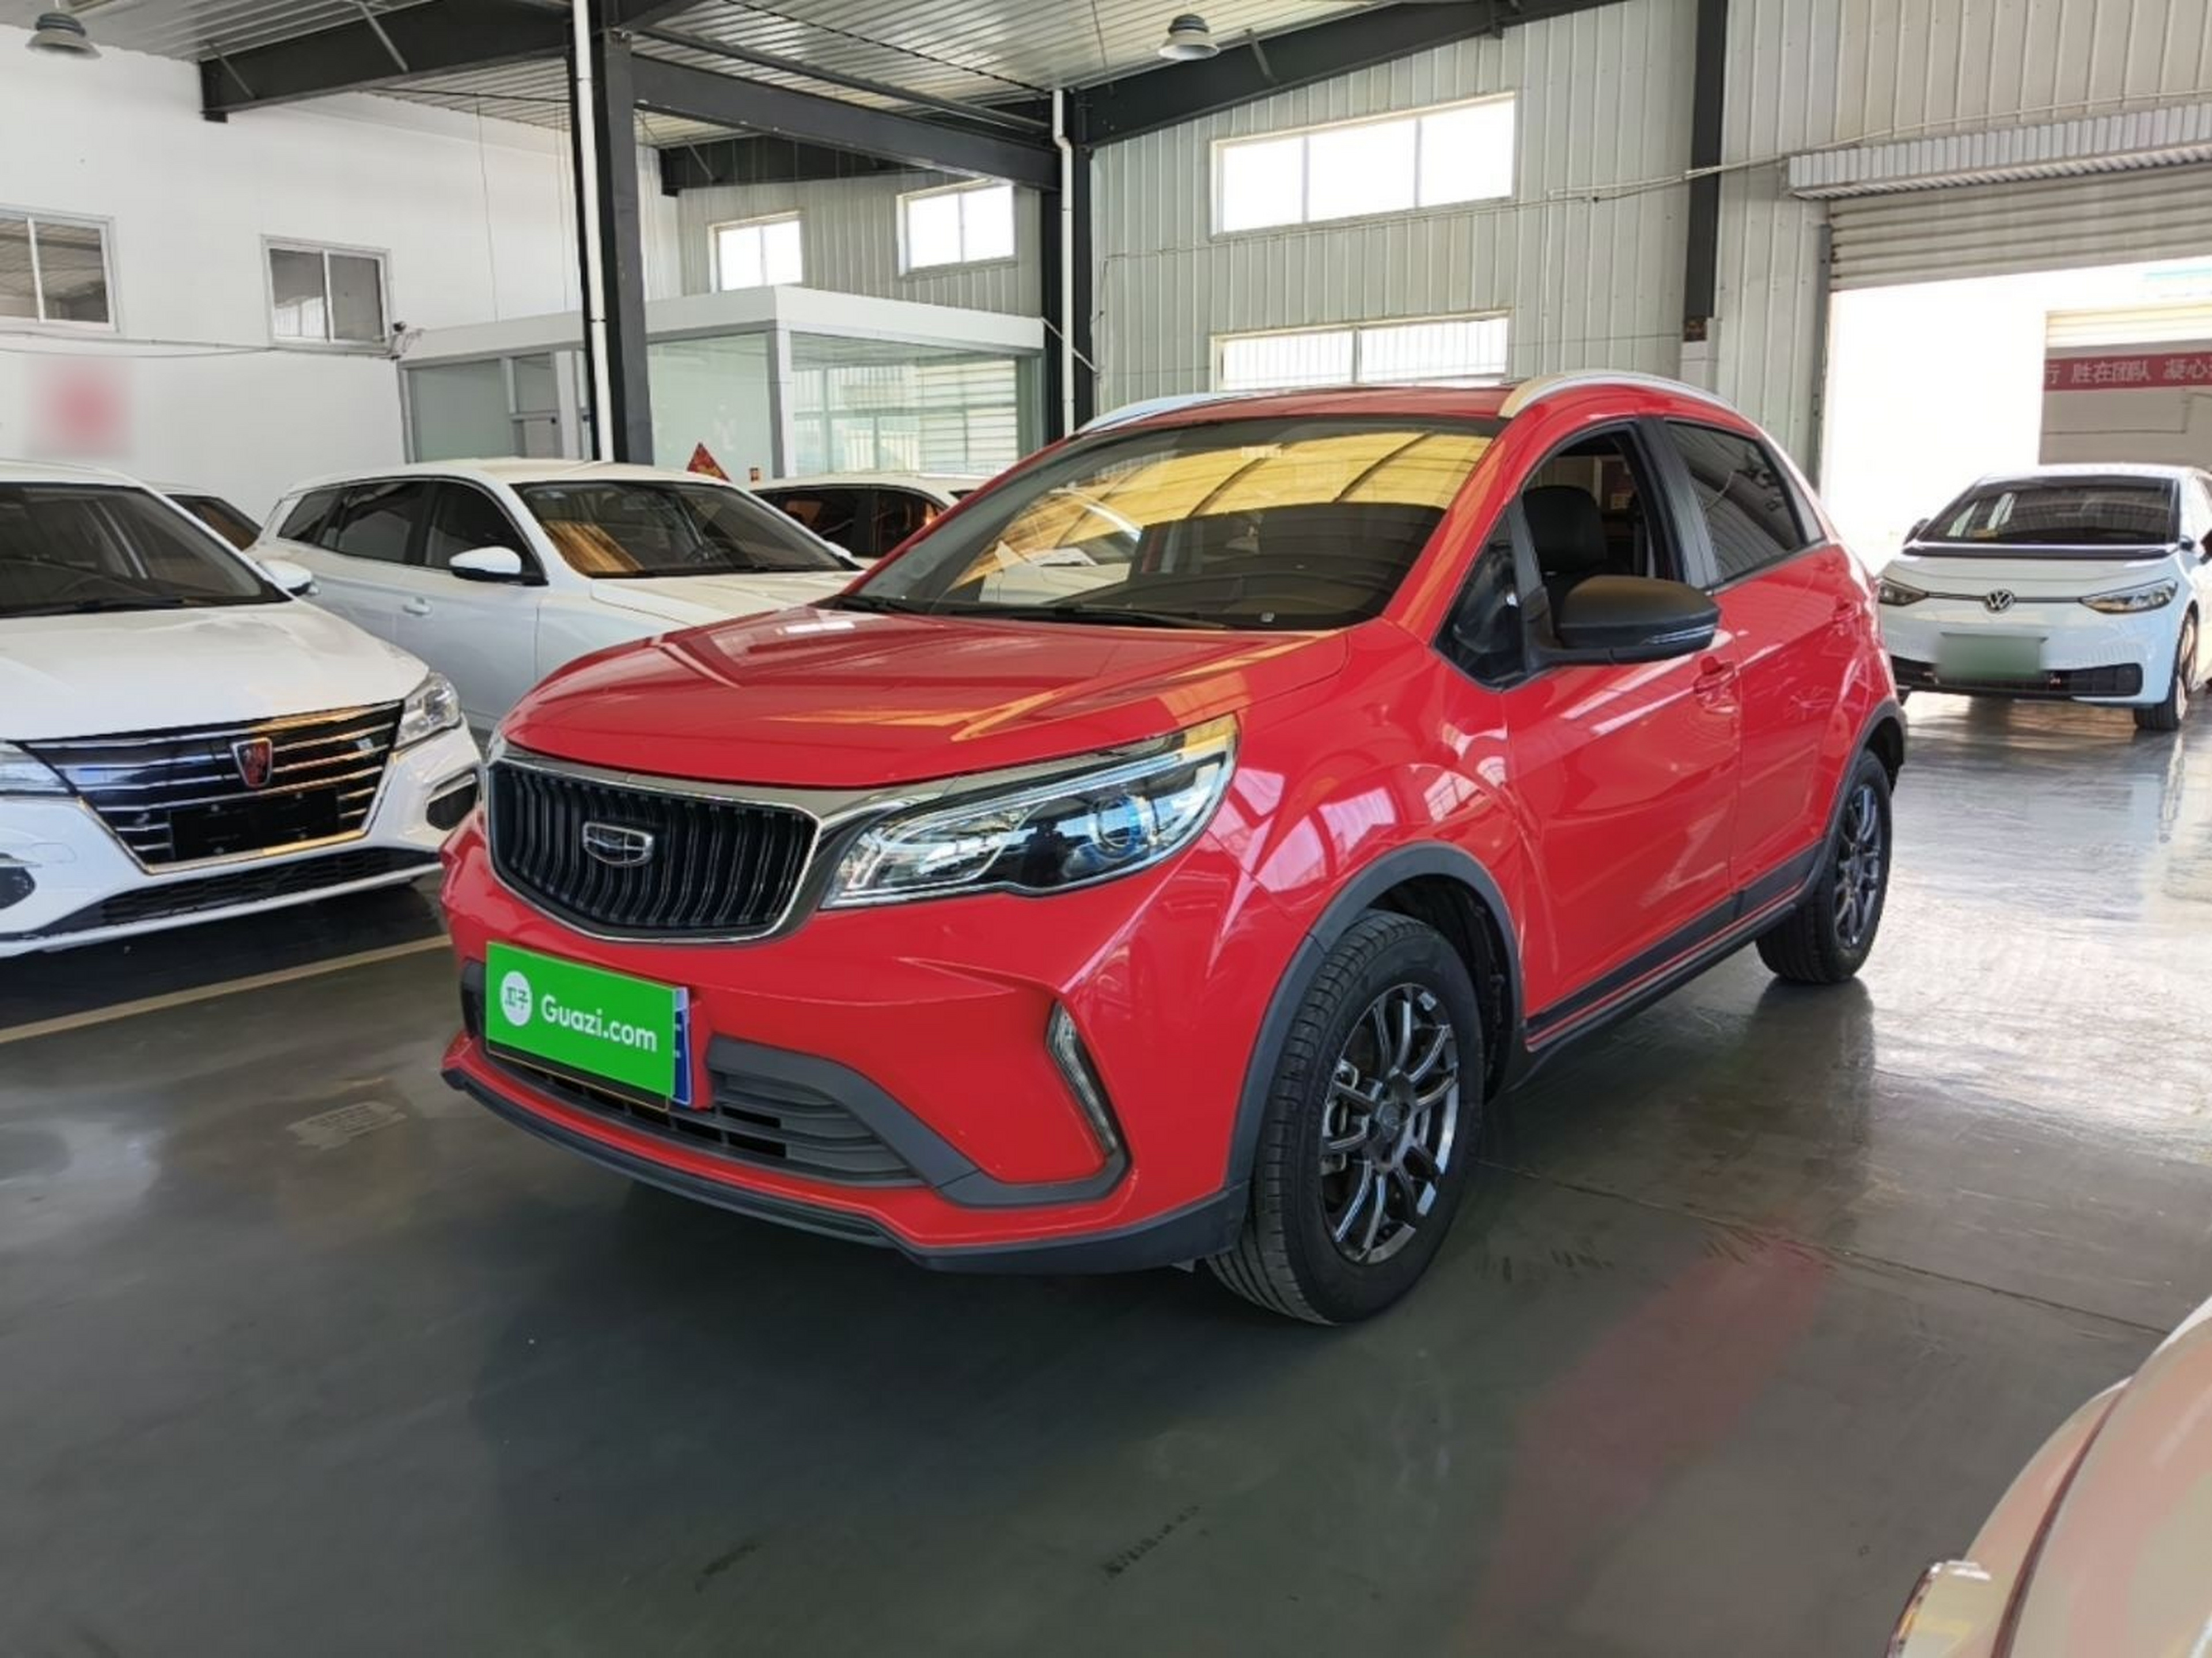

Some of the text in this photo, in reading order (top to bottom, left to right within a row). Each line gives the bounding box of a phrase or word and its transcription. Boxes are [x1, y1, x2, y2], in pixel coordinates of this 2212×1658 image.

[2071, 359, 2152, 384] 胜在团队
[2162, 355, 2212, 381] 凝心
